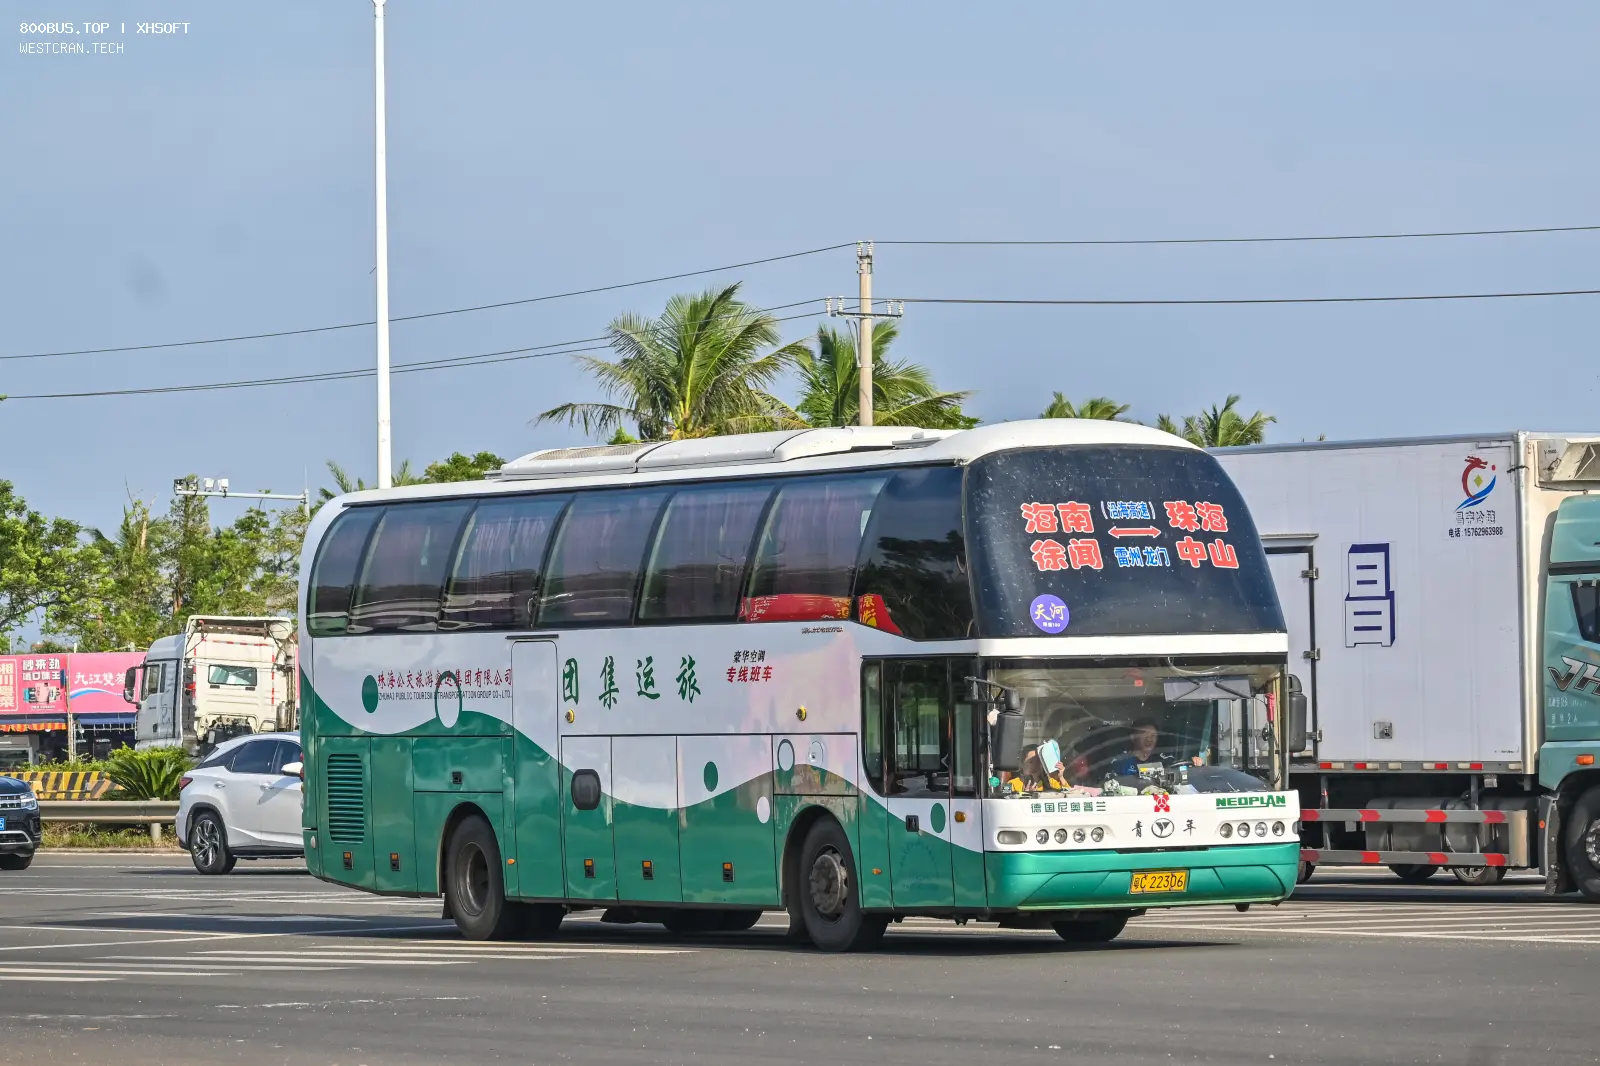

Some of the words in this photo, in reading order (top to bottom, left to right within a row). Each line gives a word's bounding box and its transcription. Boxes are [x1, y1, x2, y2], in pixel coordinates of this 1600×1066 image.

[1021, 501, 1094, 533] 海南
[1163, 500, 1228, 532] 珠海
[1030, 538, 1104, 571] 徐闻
[1113, 546, 1144, 568] 雷州
[1142, 545, 1171, 567] 龙门
[1176, 535, 1240, 569] 中山
[1034, 602, 1067, 621] 天河
[733, 649, 766, 663] 豪华空调
[726, 665, 773, 683] 专线班车
[396, 691, 412, 700] PUBLIC
[413, 691, 433, 700] TOURISM
[476, 690, 492, 699] GROUP
[1030, 801, 1107, 813] 德国尼奥普兰
[1216, 794, 1286, 808] NEOPLAN
